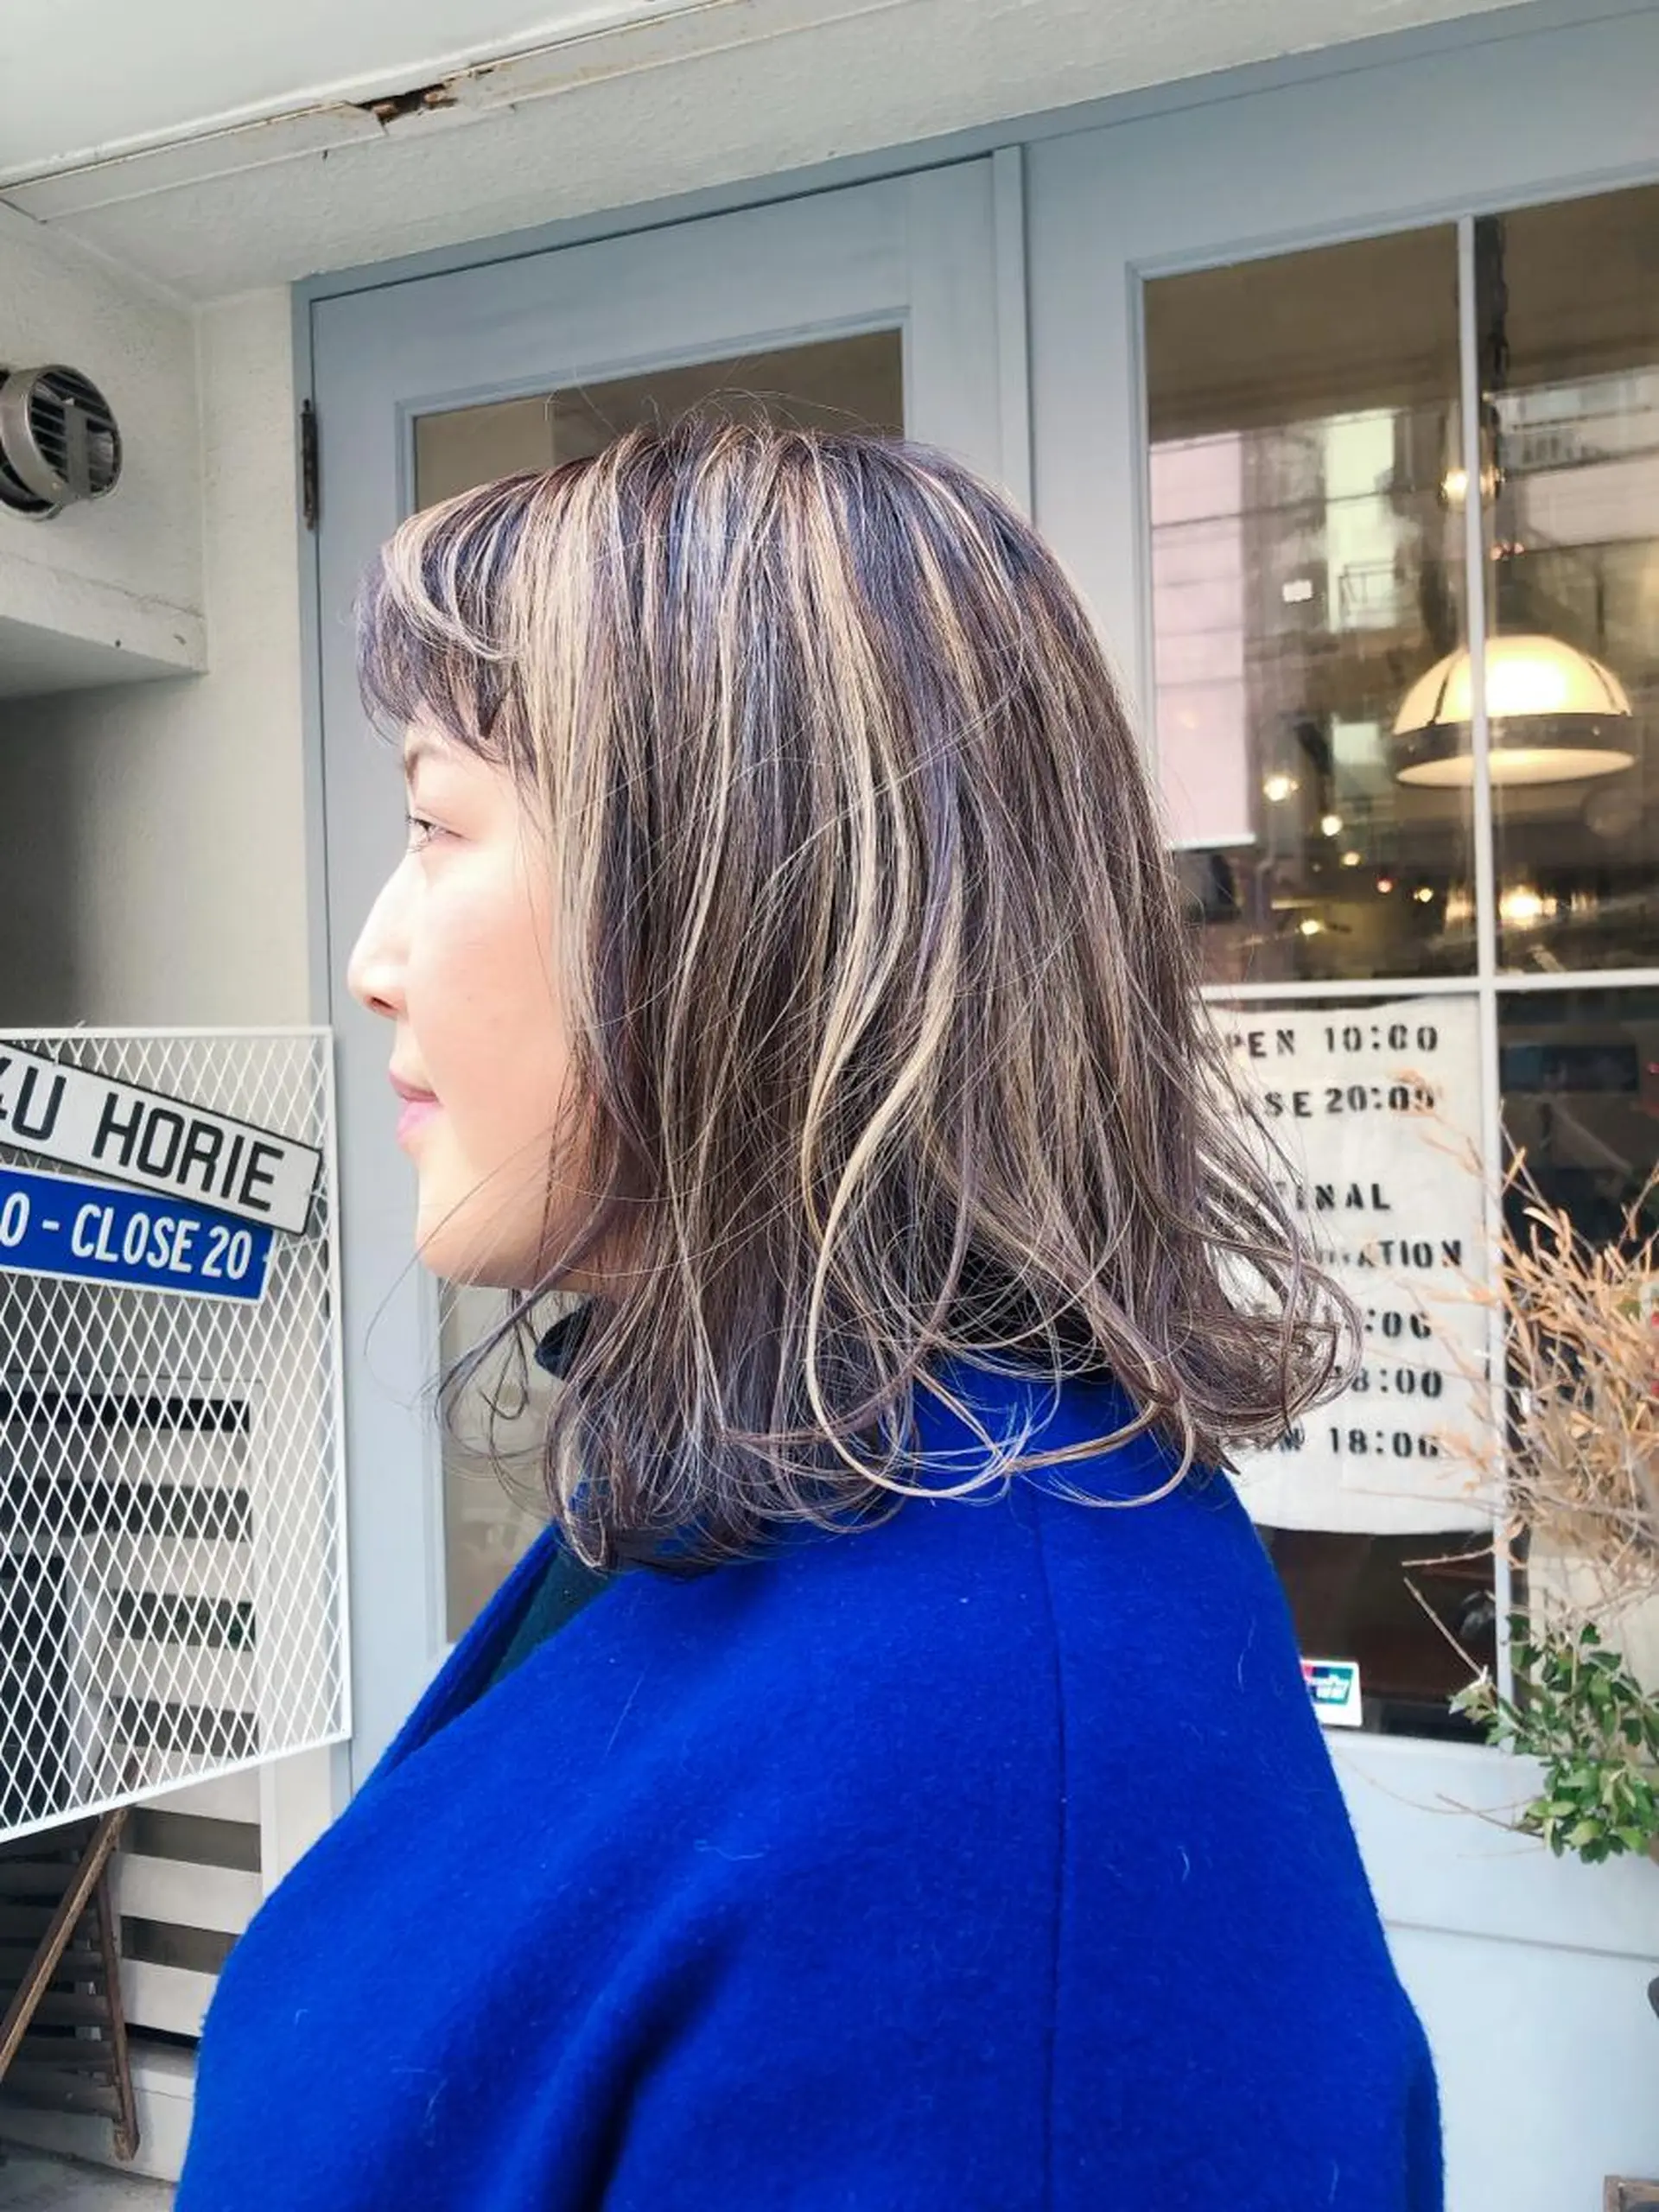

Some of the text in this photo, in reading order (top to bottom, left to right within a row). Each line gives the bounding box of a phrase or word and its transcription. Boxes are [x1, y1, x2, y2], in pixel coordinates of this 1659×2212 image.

[1223, 1023, 1439, 1058] PEN 10:00
[1264, 1090, 1313, 1118] SE
[92, 1092, 284, 1212] HORIE
[71, 1204, 200, 1274] CLOSE
[200, 1226, 252, 1281] 20
